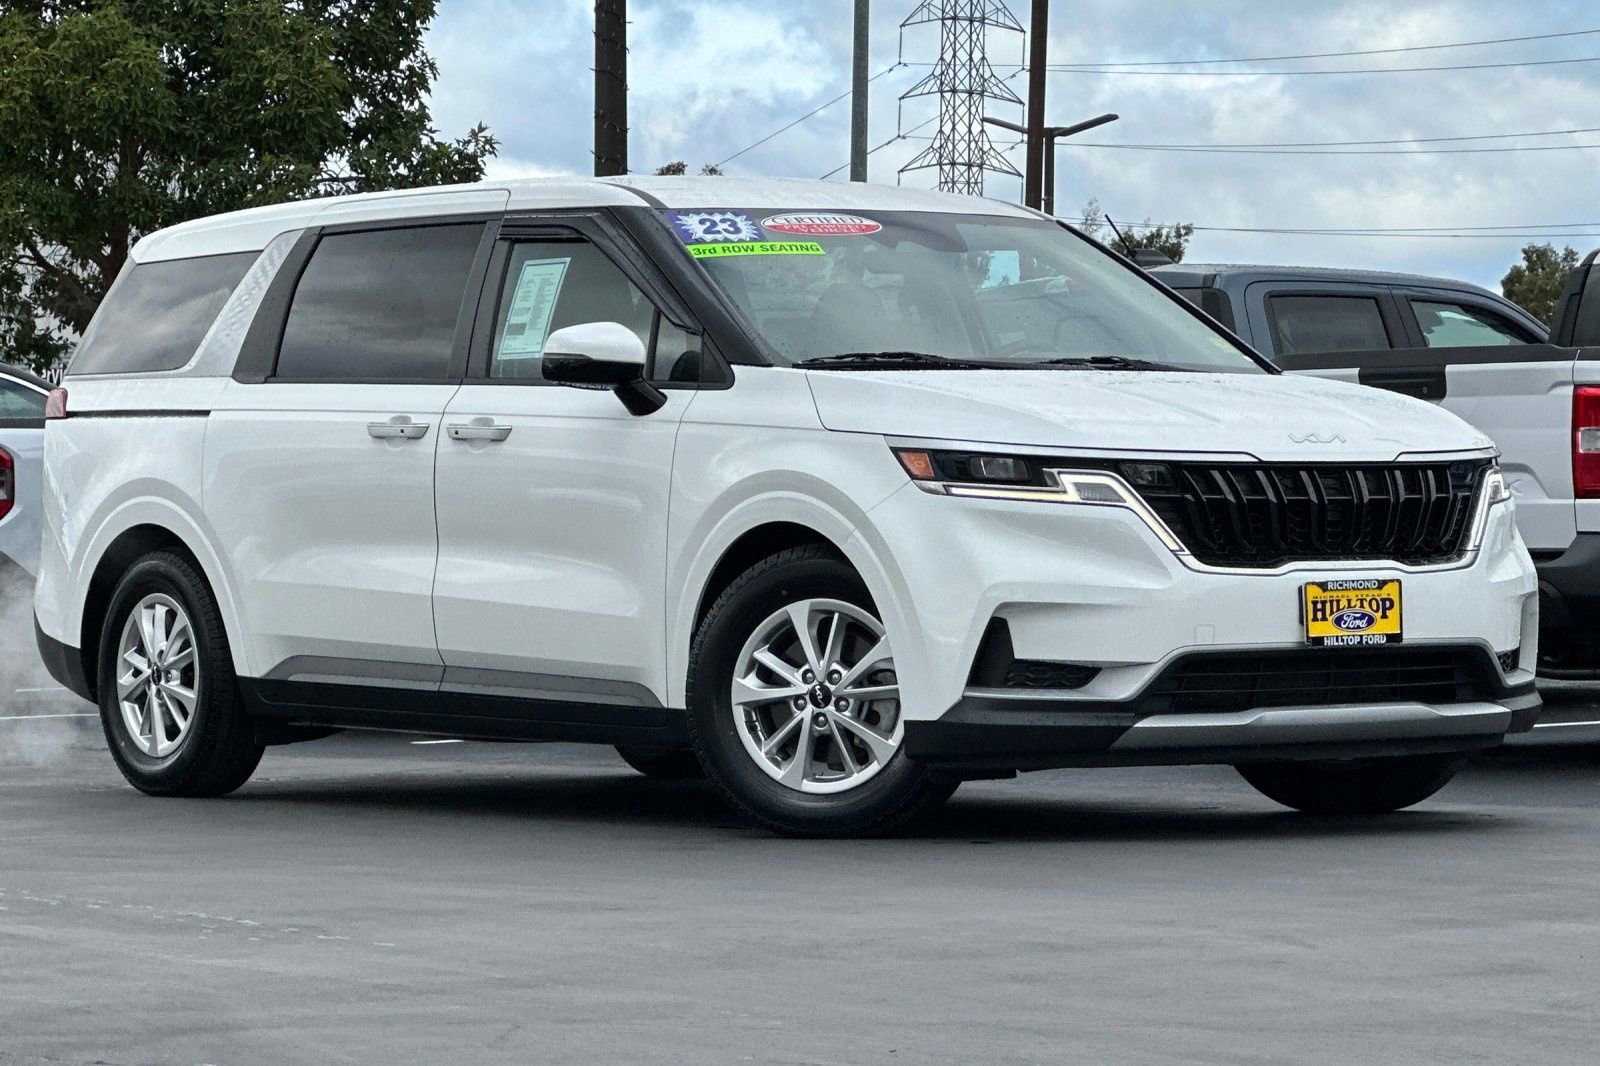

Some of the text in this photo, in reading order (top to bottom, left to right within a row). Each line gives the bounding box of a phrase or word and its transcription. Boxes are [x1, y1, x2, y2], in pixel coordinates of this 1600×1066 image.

[698, 217, 743, 235] 23
[771, 215, 864, 225] CERTIFIED
[692, 243, 821, 256] 3rd ROW SEATING
[1327, 580, 1379, 590] RICHMOND
[1311, 597, 1395, 622] HILLTOP
[1340, 612, 1368, 628] Ford
[1323, 634, 1387, 646] HILLTOP FORD
